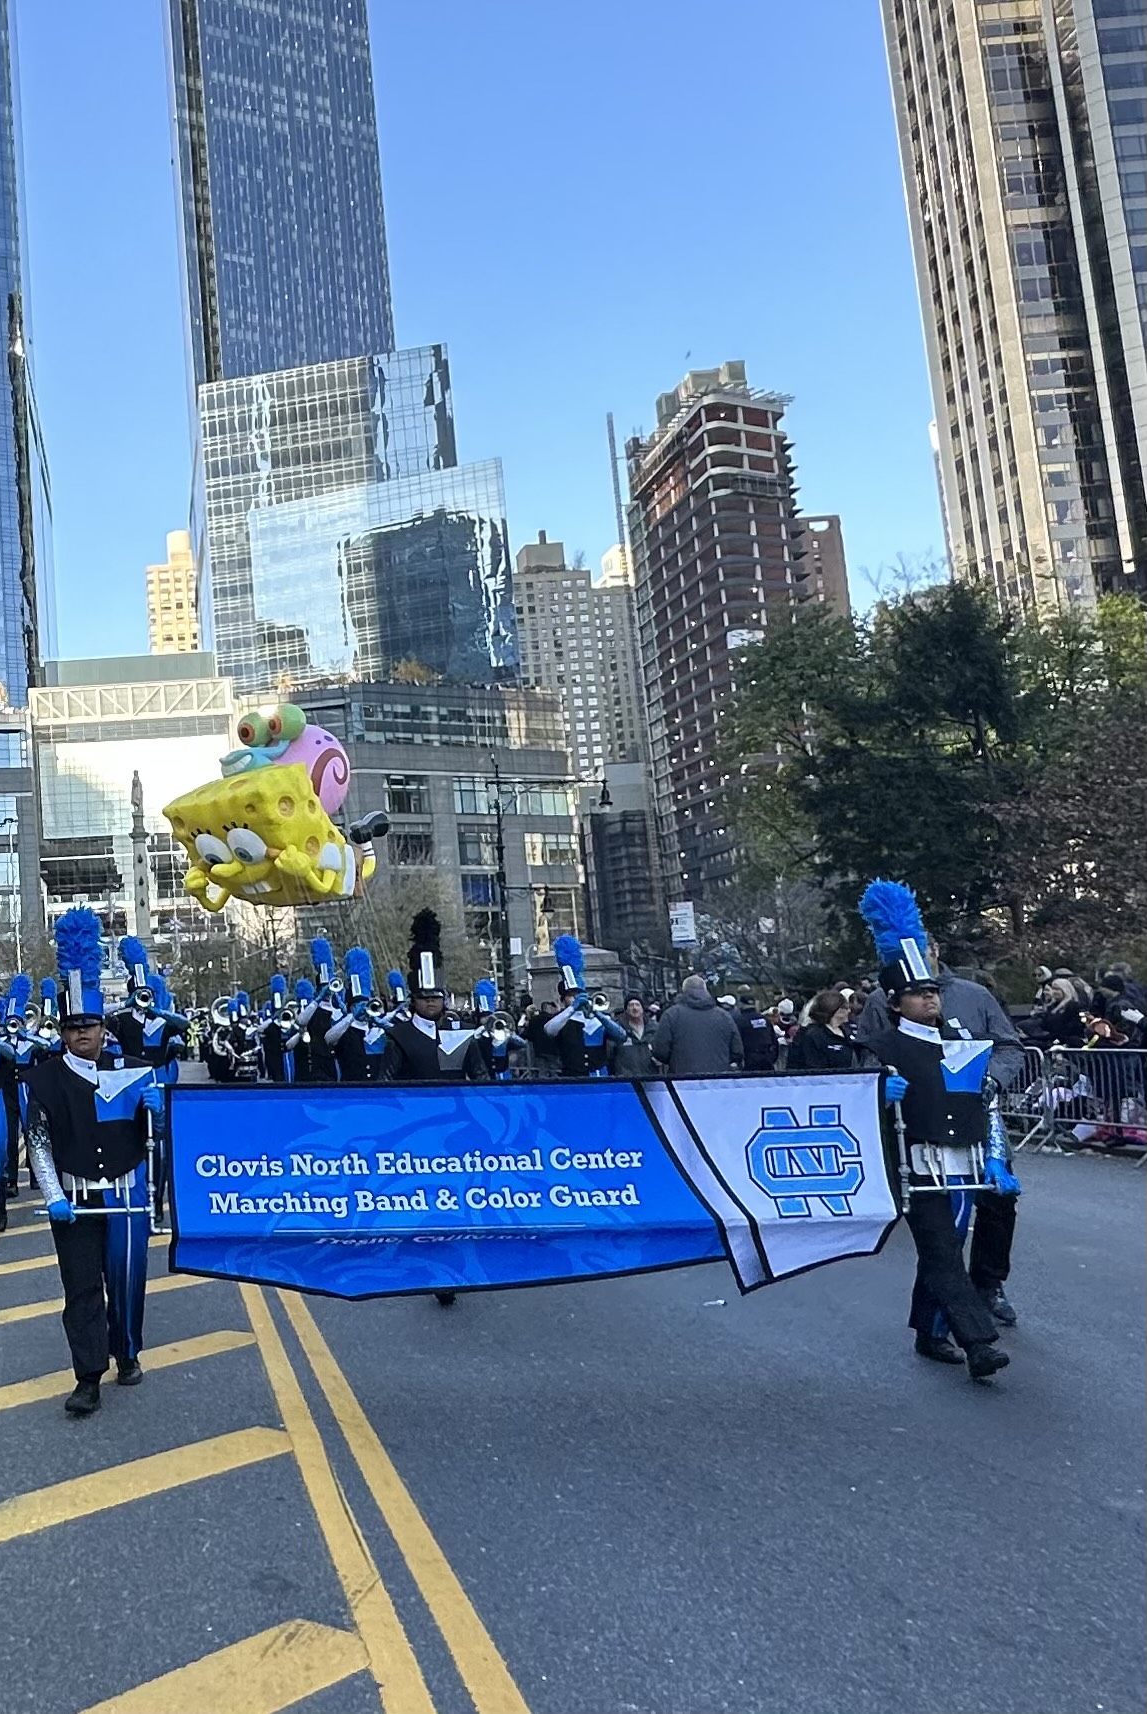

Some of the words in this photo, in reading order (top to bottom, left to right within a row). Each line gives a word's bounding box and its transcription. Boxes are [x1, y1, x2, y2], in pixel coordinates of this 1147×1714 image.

[195, 1154, 284, 1177] Clovis
[290, 1152, 370, 1176] North
[375, 1149, 544, 1175] Educational
[549, 1147, 643, 1170] Center
[208, 1191, 349, 1218] Marching
[354, 1189, 429, 1212] Band
[435, 1188, 459, 1210] &
[465, 1186, 542, 1210] Color
[549, 1184, 641, 1208] Guard
